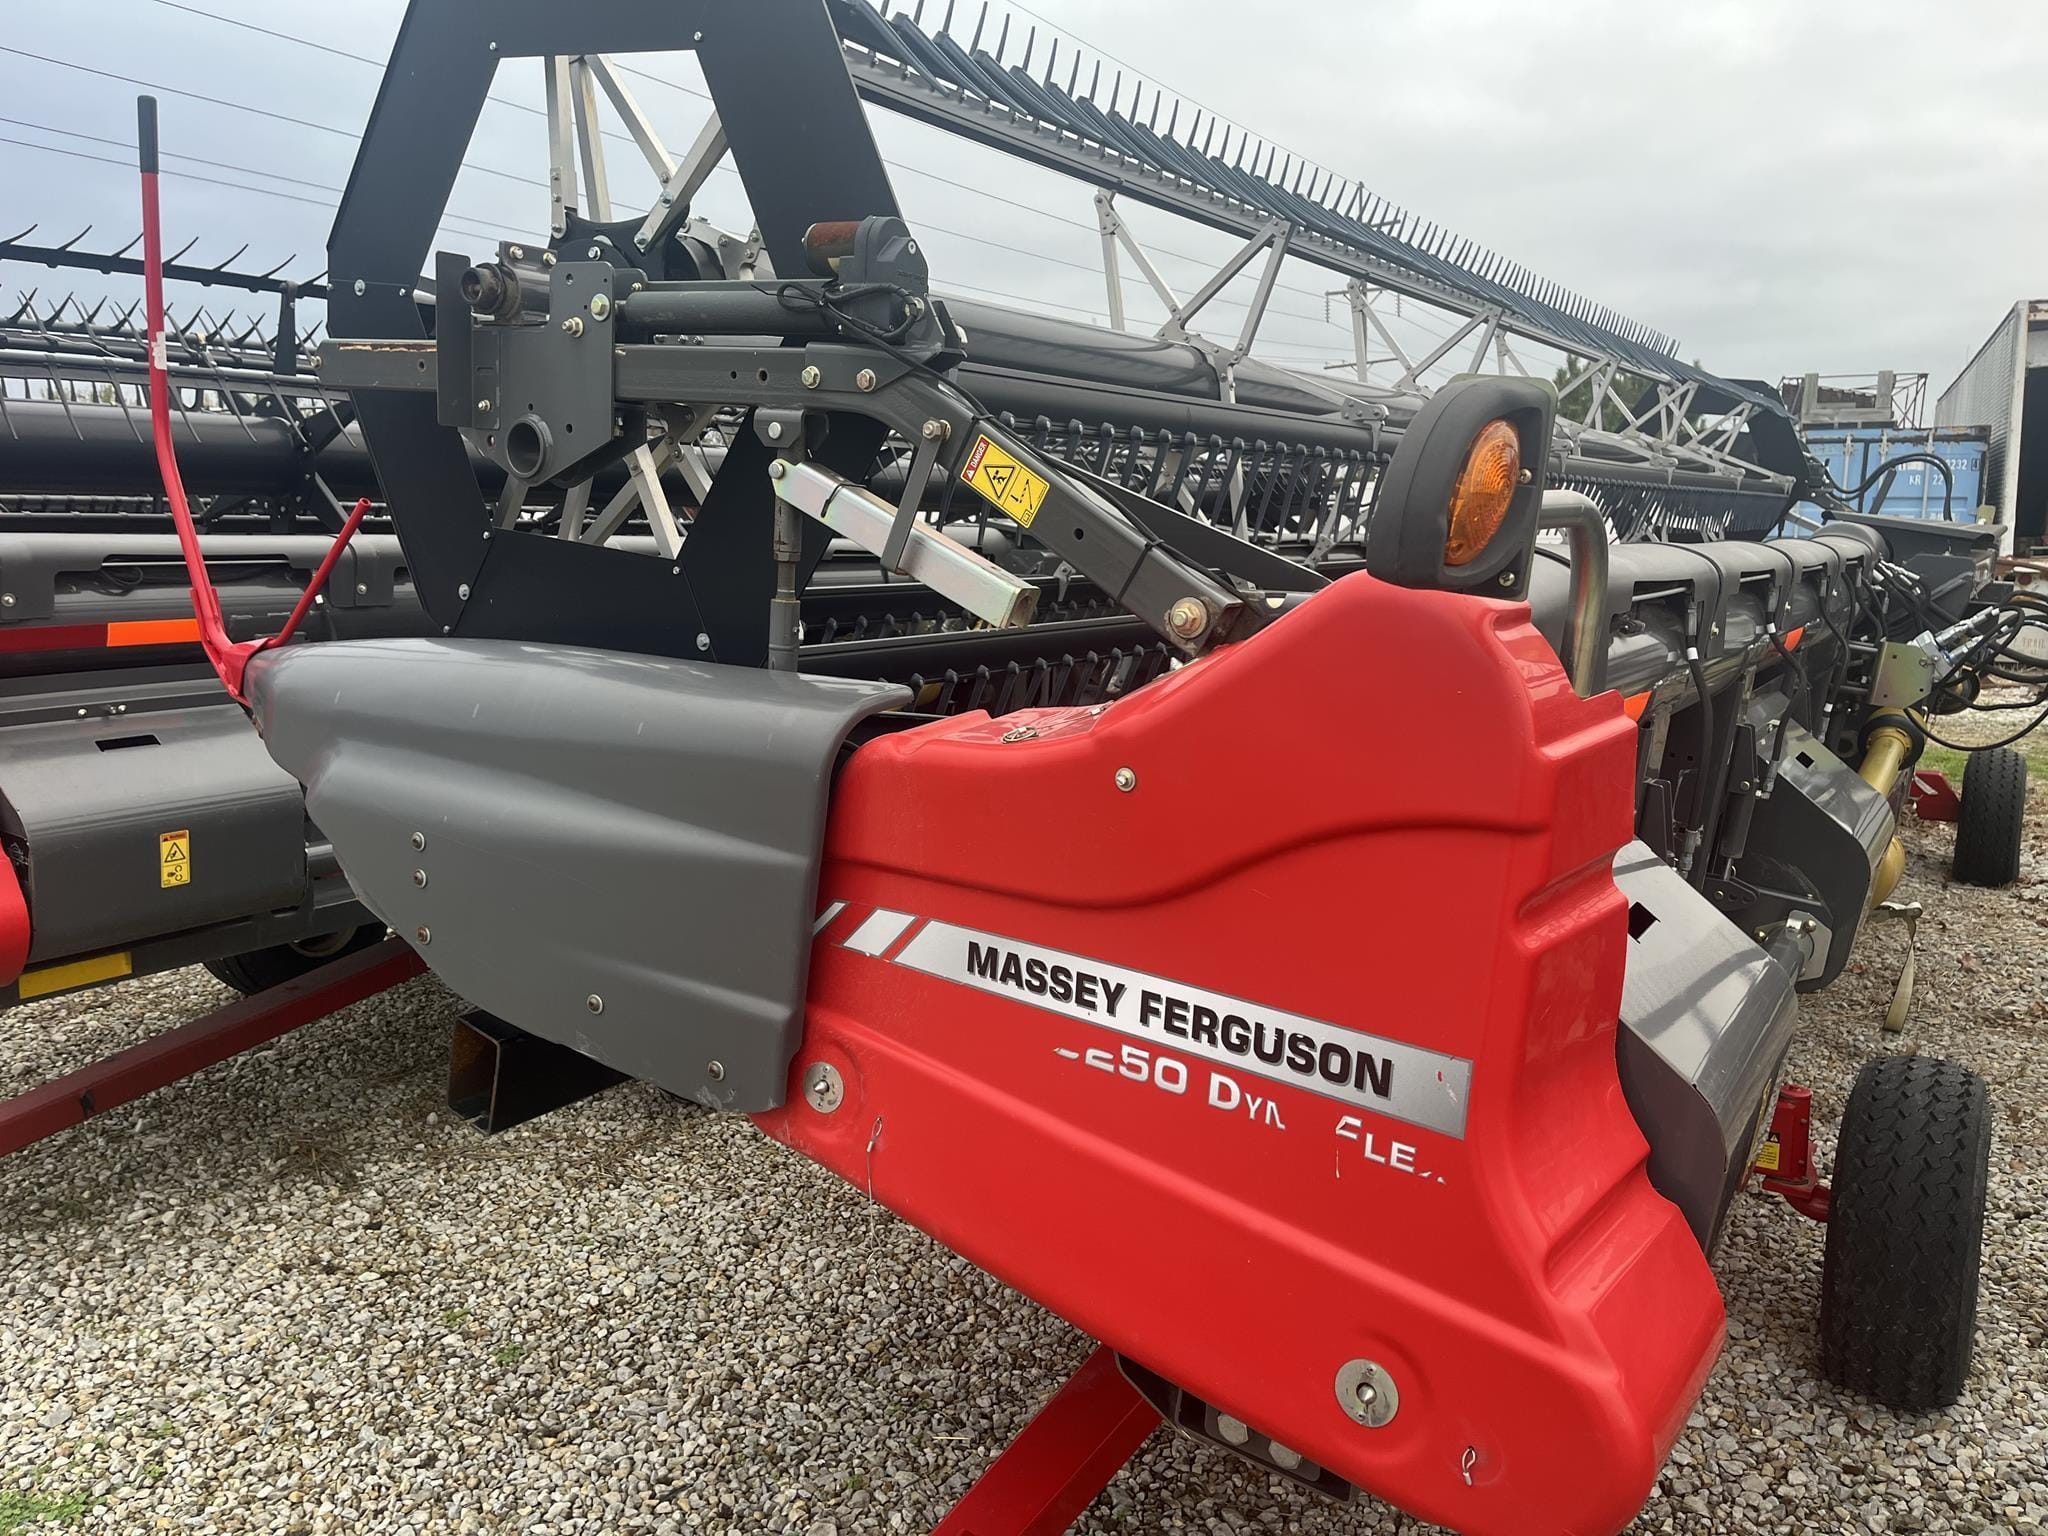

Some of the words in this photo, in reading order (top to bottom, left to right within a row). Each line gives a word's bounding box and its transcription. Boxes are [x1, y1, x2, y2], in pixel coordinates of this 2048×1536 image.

[971, 442, 987, 468] DANGER
[967, 940, 1127, 1018] MASSEY
[1139, 989, 1395, 1101] FERGUSON
[1054, 1044, 1188, 1095] 250
